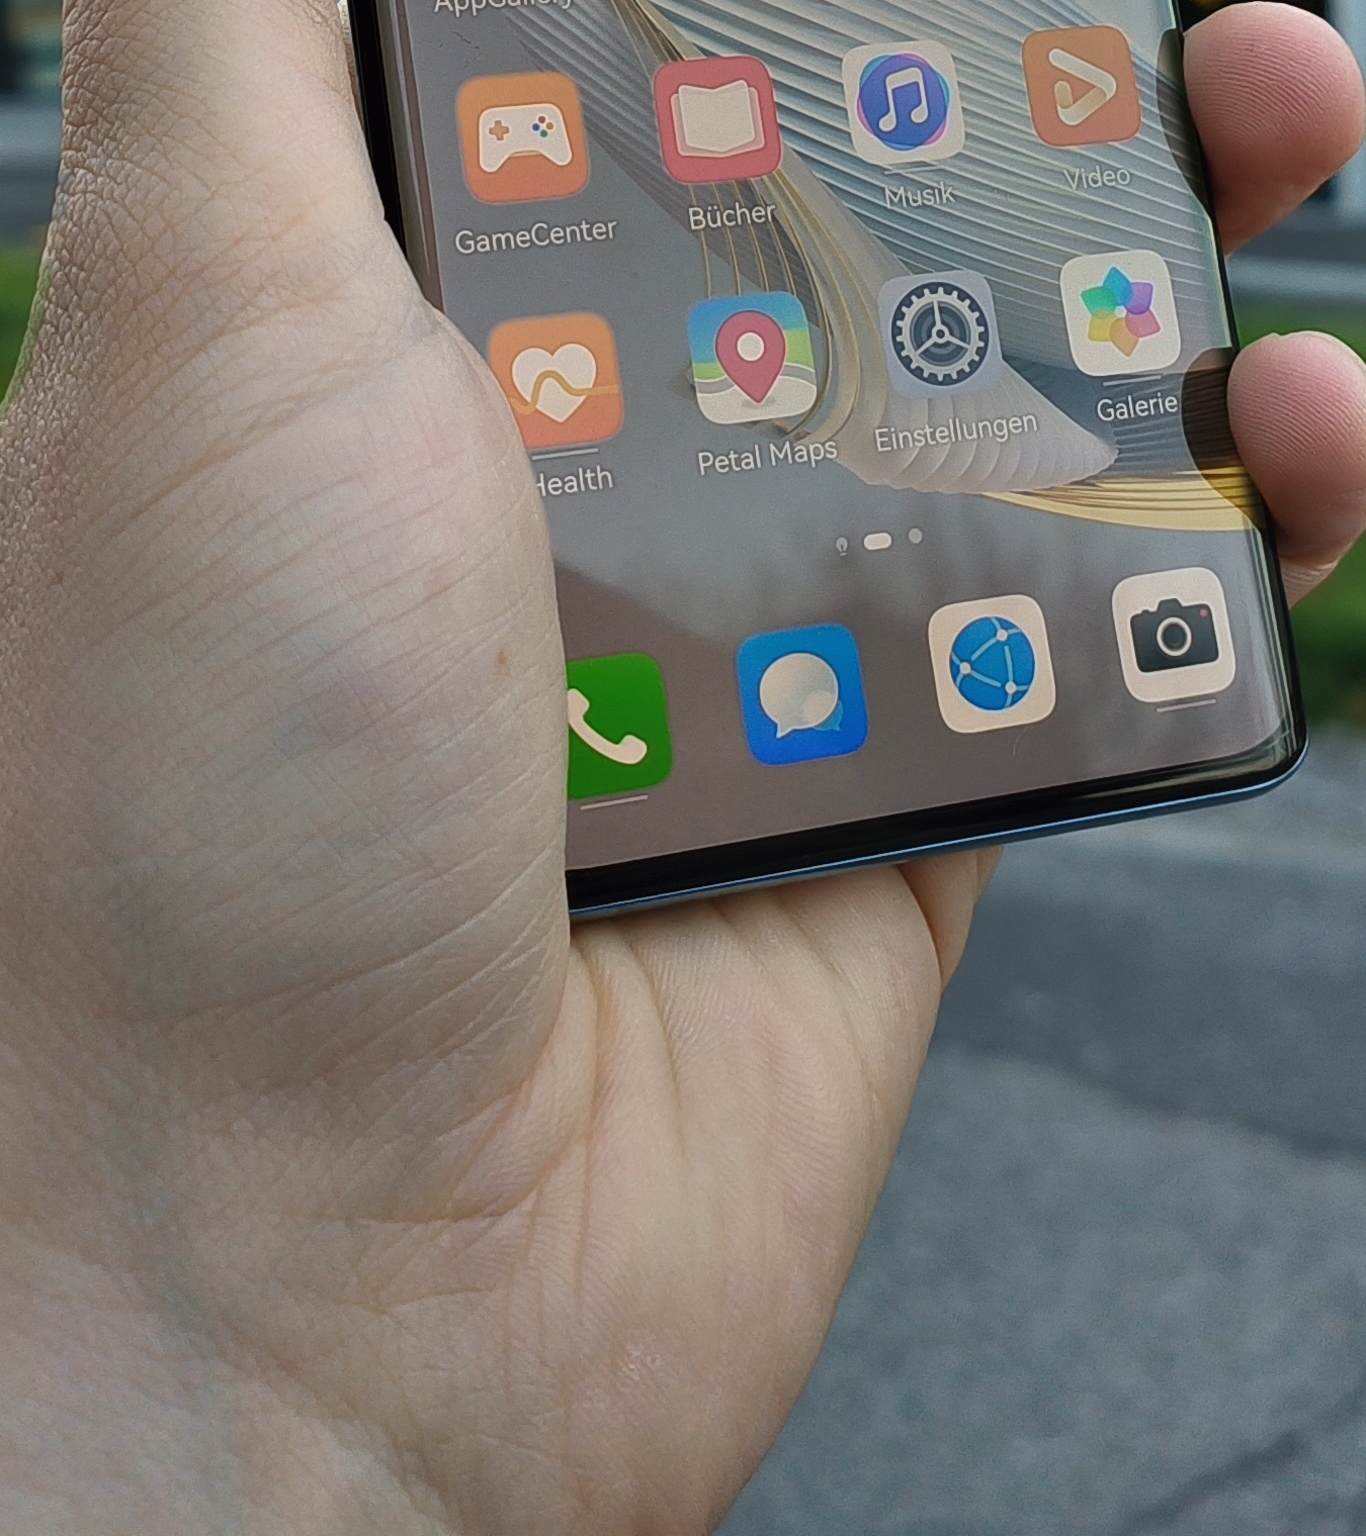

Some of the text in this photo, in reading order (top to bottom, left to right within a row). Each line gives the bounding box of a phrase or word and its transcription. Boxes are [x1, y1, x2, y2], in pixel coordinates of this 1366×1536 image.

[1062, 163, 1131, 191] Video
[884, 181, 956, 208] Musik
[689, 202, 776, 231] Bücher
[455, 220, 617, 255] GameCenter
[1097, 393, 1178, 421] Galerie
[875, 412, 1037, 452] Einstellungen
[697, 440, 837, 475] Petal Maps
